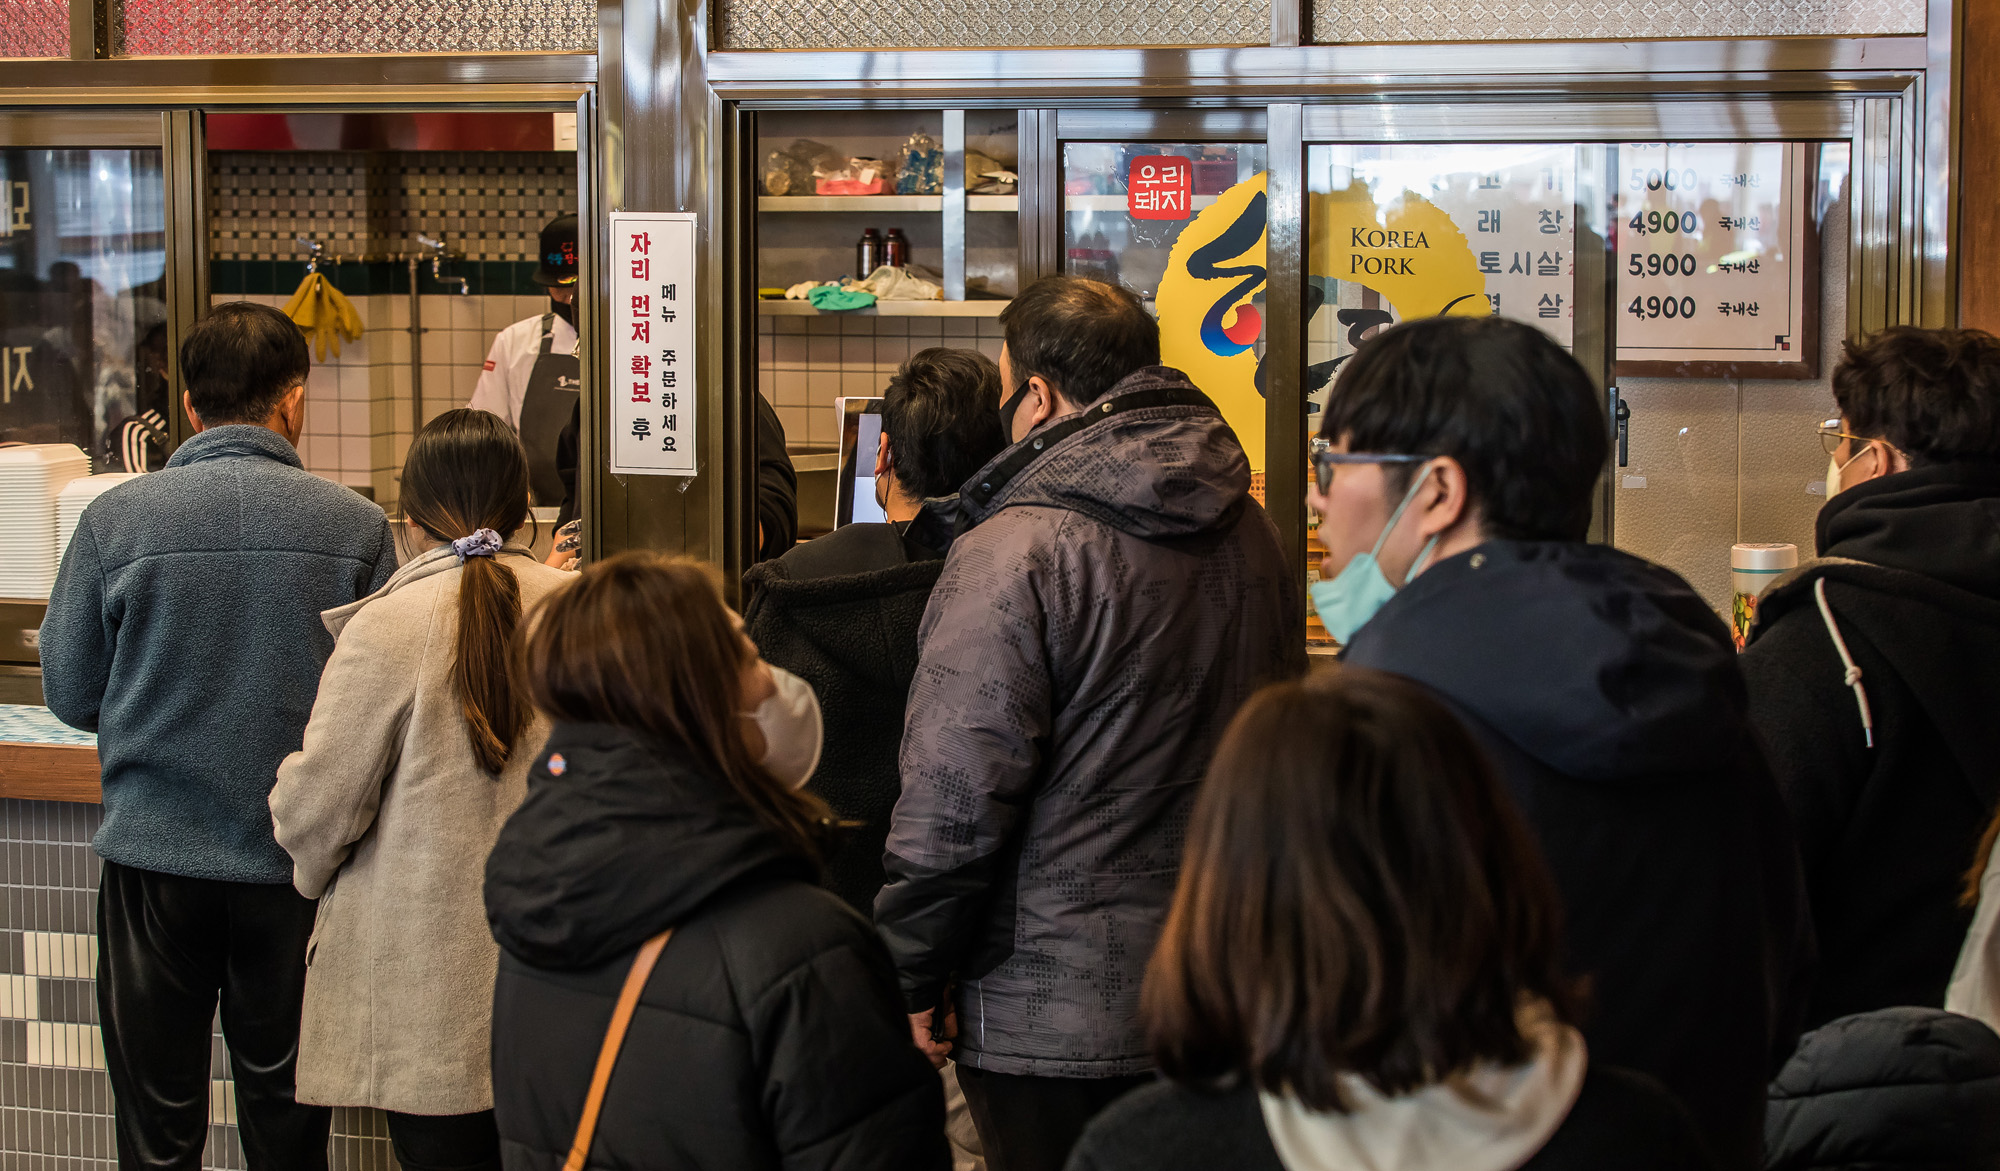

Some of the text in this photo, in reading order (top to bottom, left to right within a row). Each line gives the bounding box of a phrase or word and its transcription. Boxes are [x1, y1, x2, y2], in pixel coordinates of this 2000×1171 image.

[1136, 164, 1185, 188] 우리
[1629, 168, 1761, 193] 5,000 국내산
[1134, 189, 1185, 211] 돼지
[1628, 210, 1761, 237] 4,900 국내산
[1350, 227, 1431, 249] KOREA
[1350, 254, 1417, 276] PORK
[1628, 253, 1761, 279] 5,900 국내산
[1627, 295, 1760, 321] 4,900 국내산
[630, 232, 652, 441] 자리 먼저 확보 후
[661, 283, 677, 452] 메뉴 주문하세요
